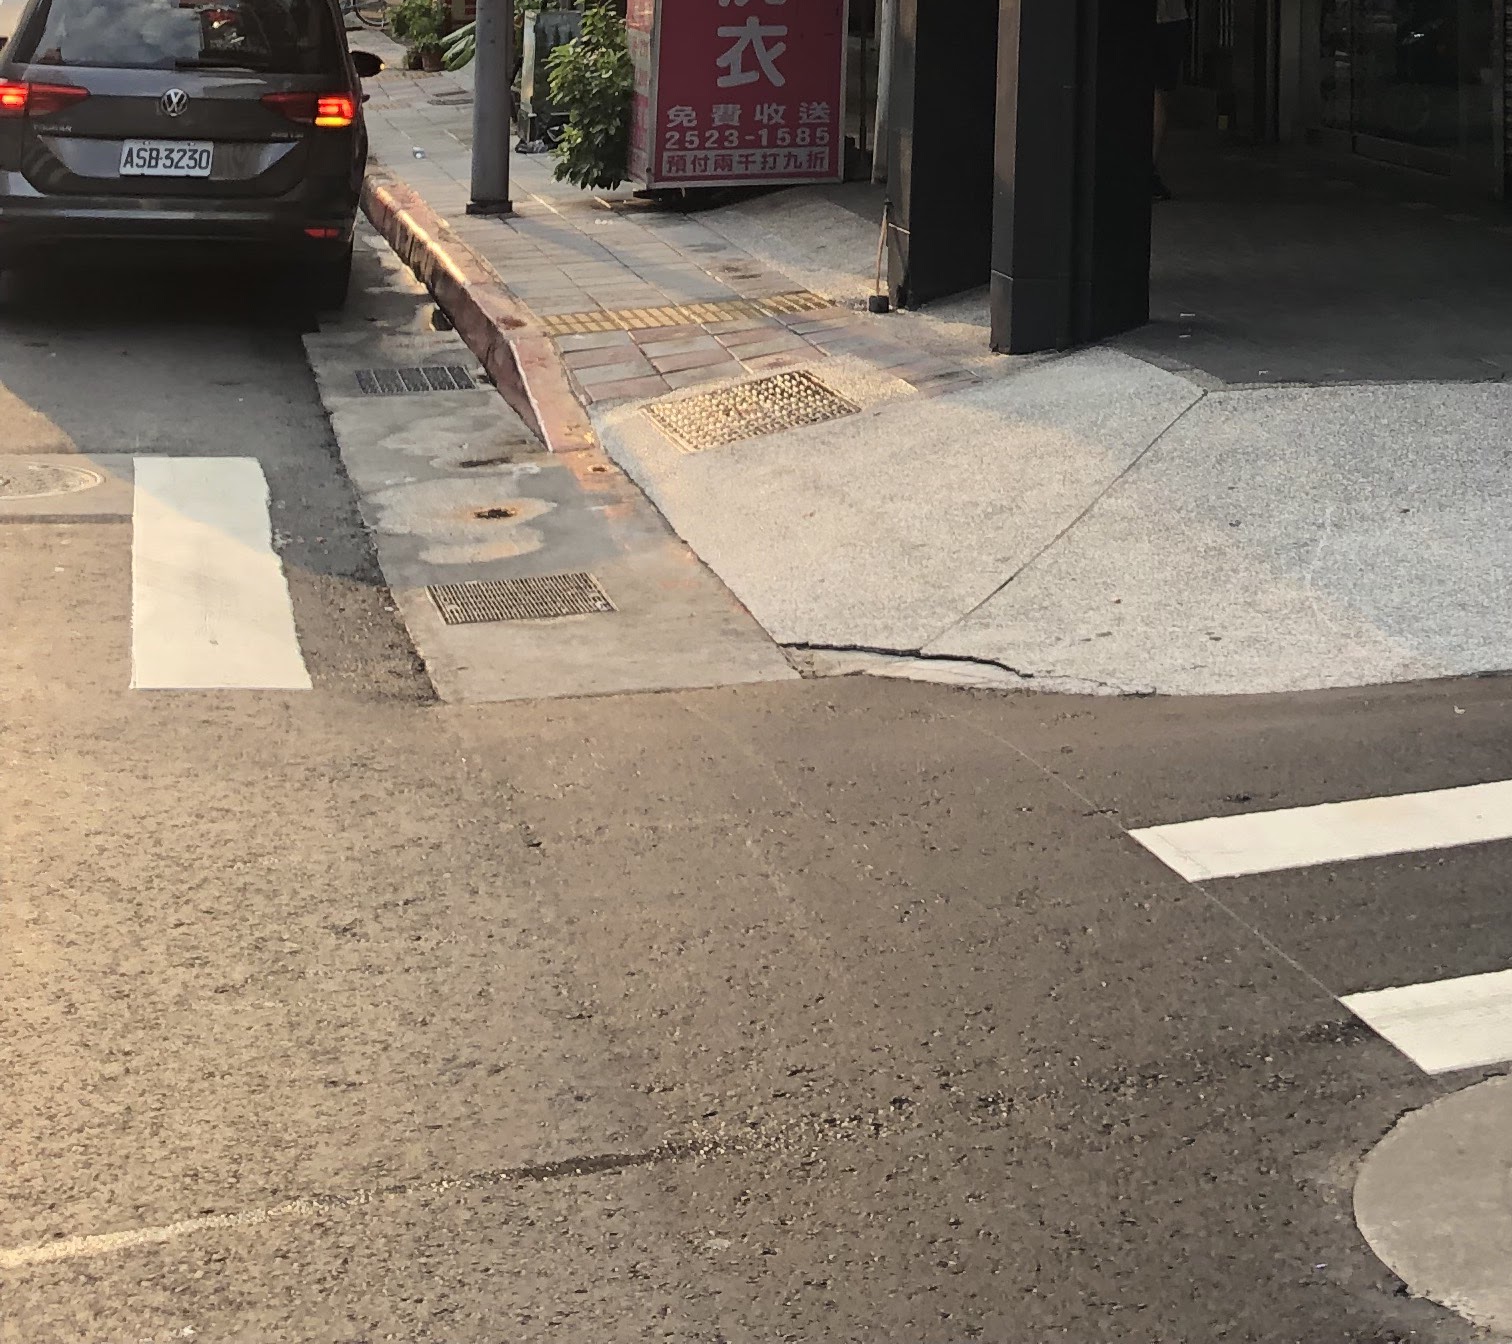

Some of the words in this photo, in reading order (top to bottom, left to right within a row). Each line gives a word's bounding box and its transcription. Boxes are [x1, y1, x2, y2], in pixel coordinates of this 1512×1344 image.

[665, 100, 831, 129] 免費收送
[664, 127, 830, 150] 2523-1585
[122, 146, 212, 171] ASB-3230
[664, 150, 828, 175] 預付兩千打九折
